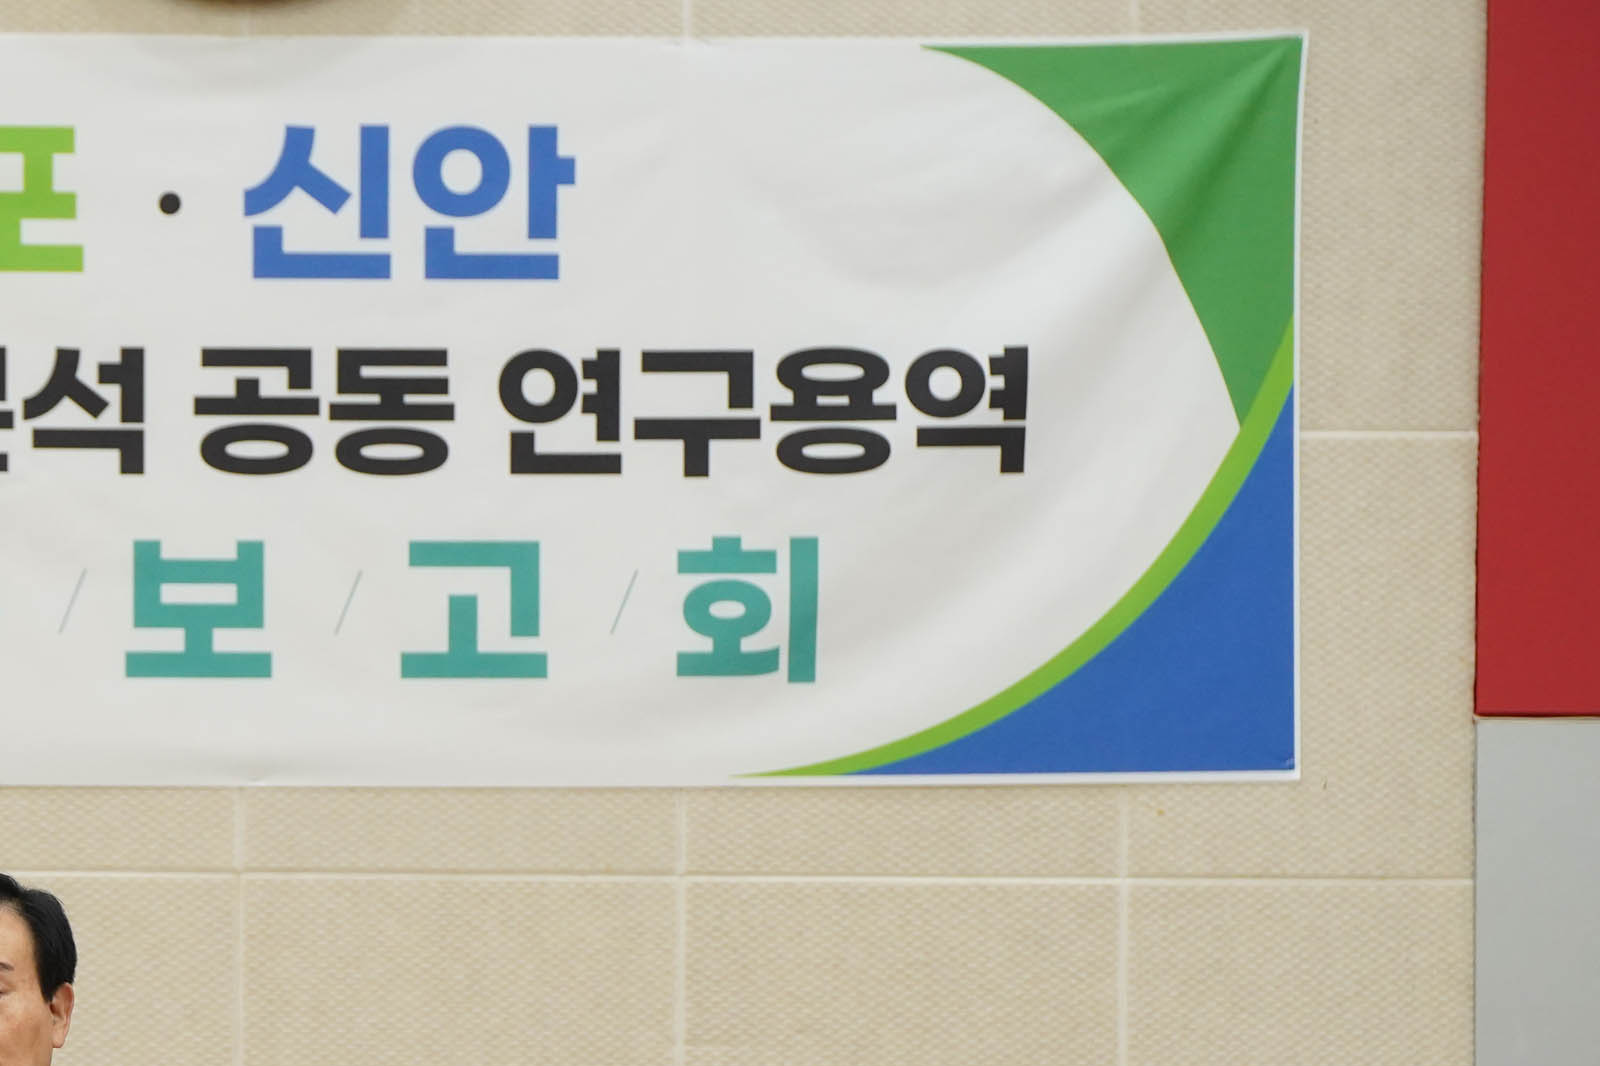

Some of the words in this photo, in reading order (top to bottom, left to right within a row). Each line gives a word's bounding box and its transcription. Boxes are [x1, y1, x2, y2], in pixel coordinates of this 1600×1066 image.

[244, 124, 576, 281] 신안
[193, 347, 456, 477] 공동
[497, 345, 1029, 478] 연구용역
